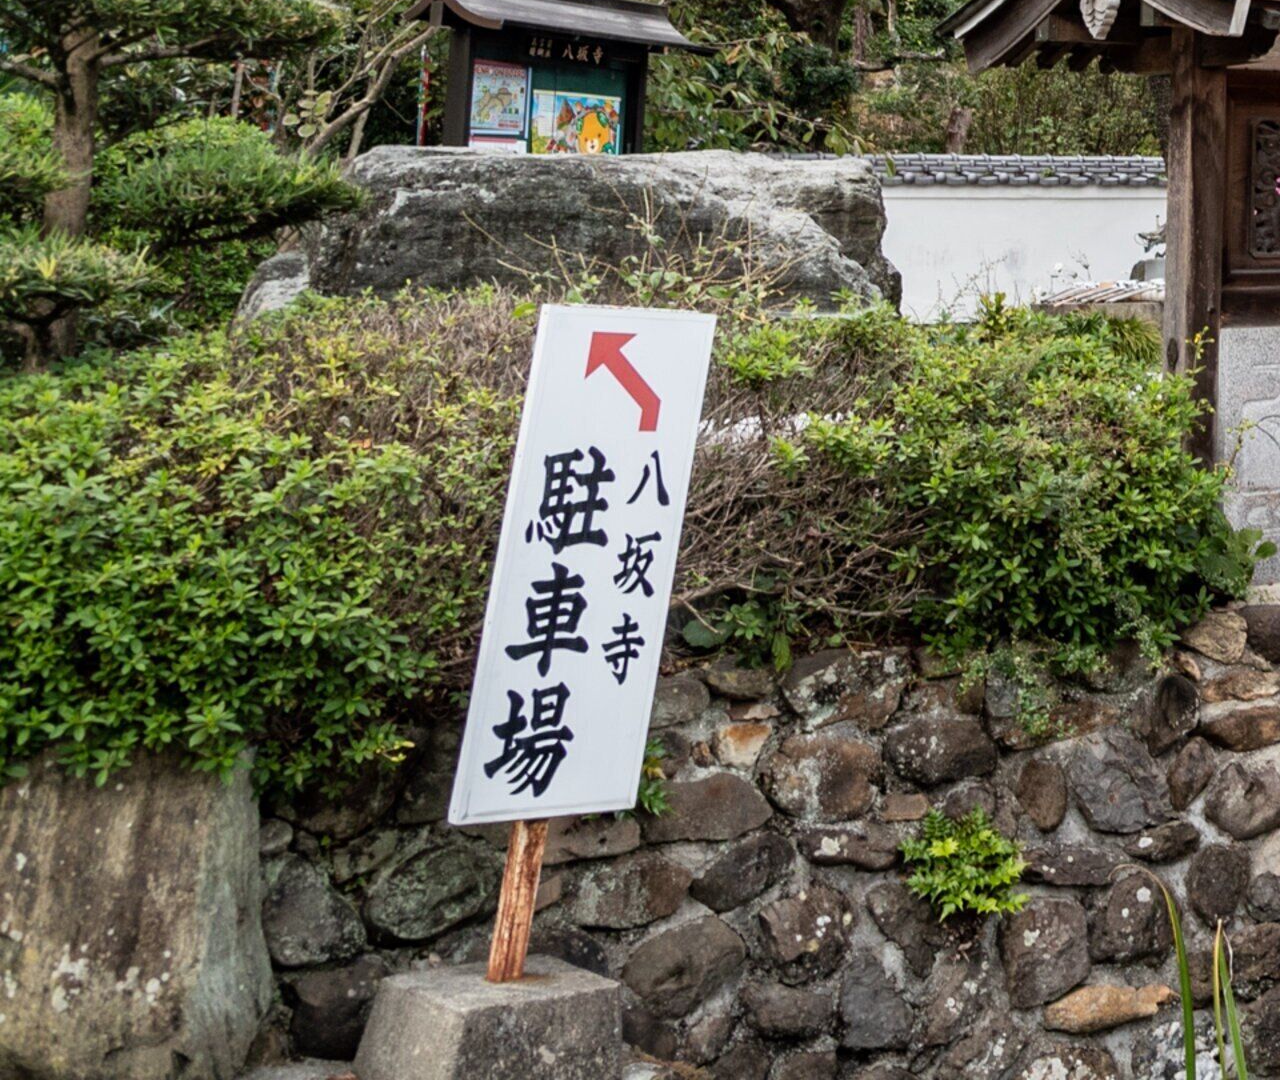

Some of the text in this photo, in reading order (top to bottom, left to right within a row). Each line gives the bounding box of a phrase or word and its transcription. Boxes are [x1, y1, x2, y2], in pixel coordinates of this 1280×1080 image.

[484, 445, 616, 798] 駐車場
[601, 450, 670, 686] 八坂寺
